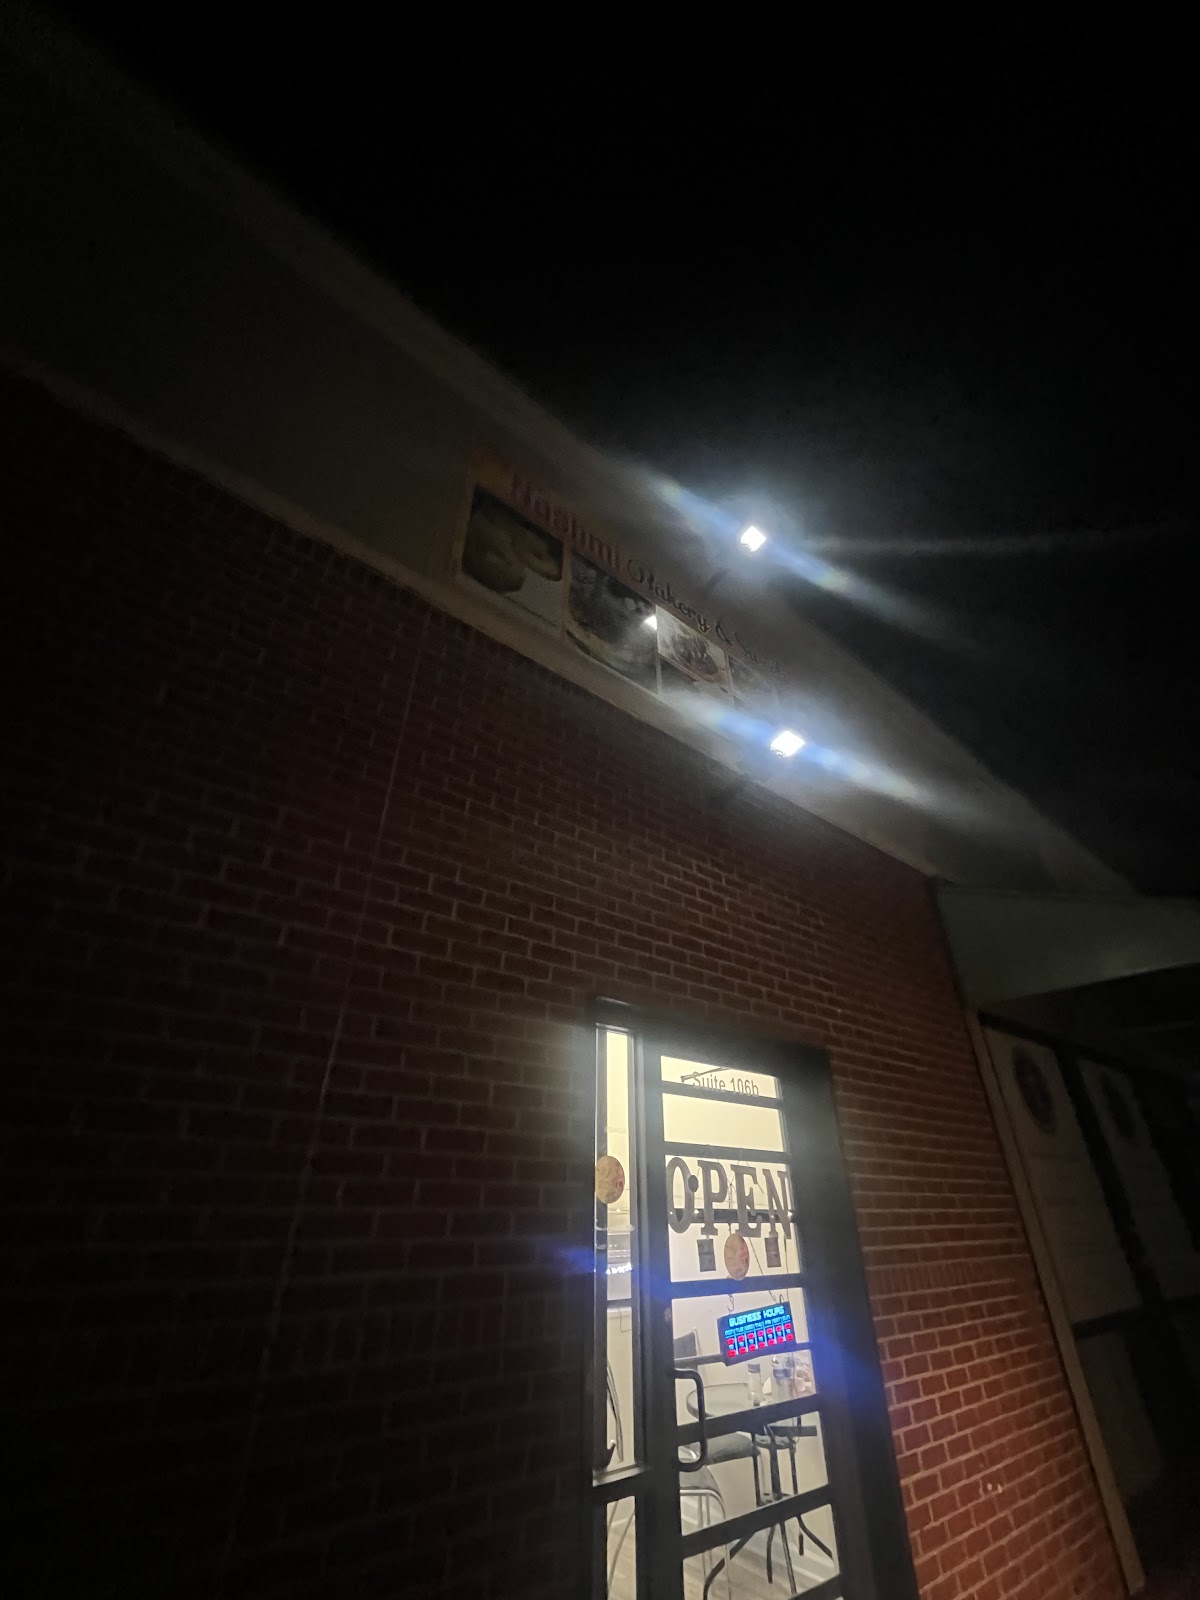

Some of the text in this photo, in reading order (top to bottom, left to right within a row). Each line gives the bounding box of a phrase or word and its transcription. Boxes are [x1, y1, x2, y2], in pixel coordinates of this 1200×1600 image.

[692, 1074, 759, 1098] Suite 106b
[666, 1156, 791, 1240] OPEN
[729, 1312, 762, 1328] BUSINESS
[763, 1305, 785, 1319] HOURS
